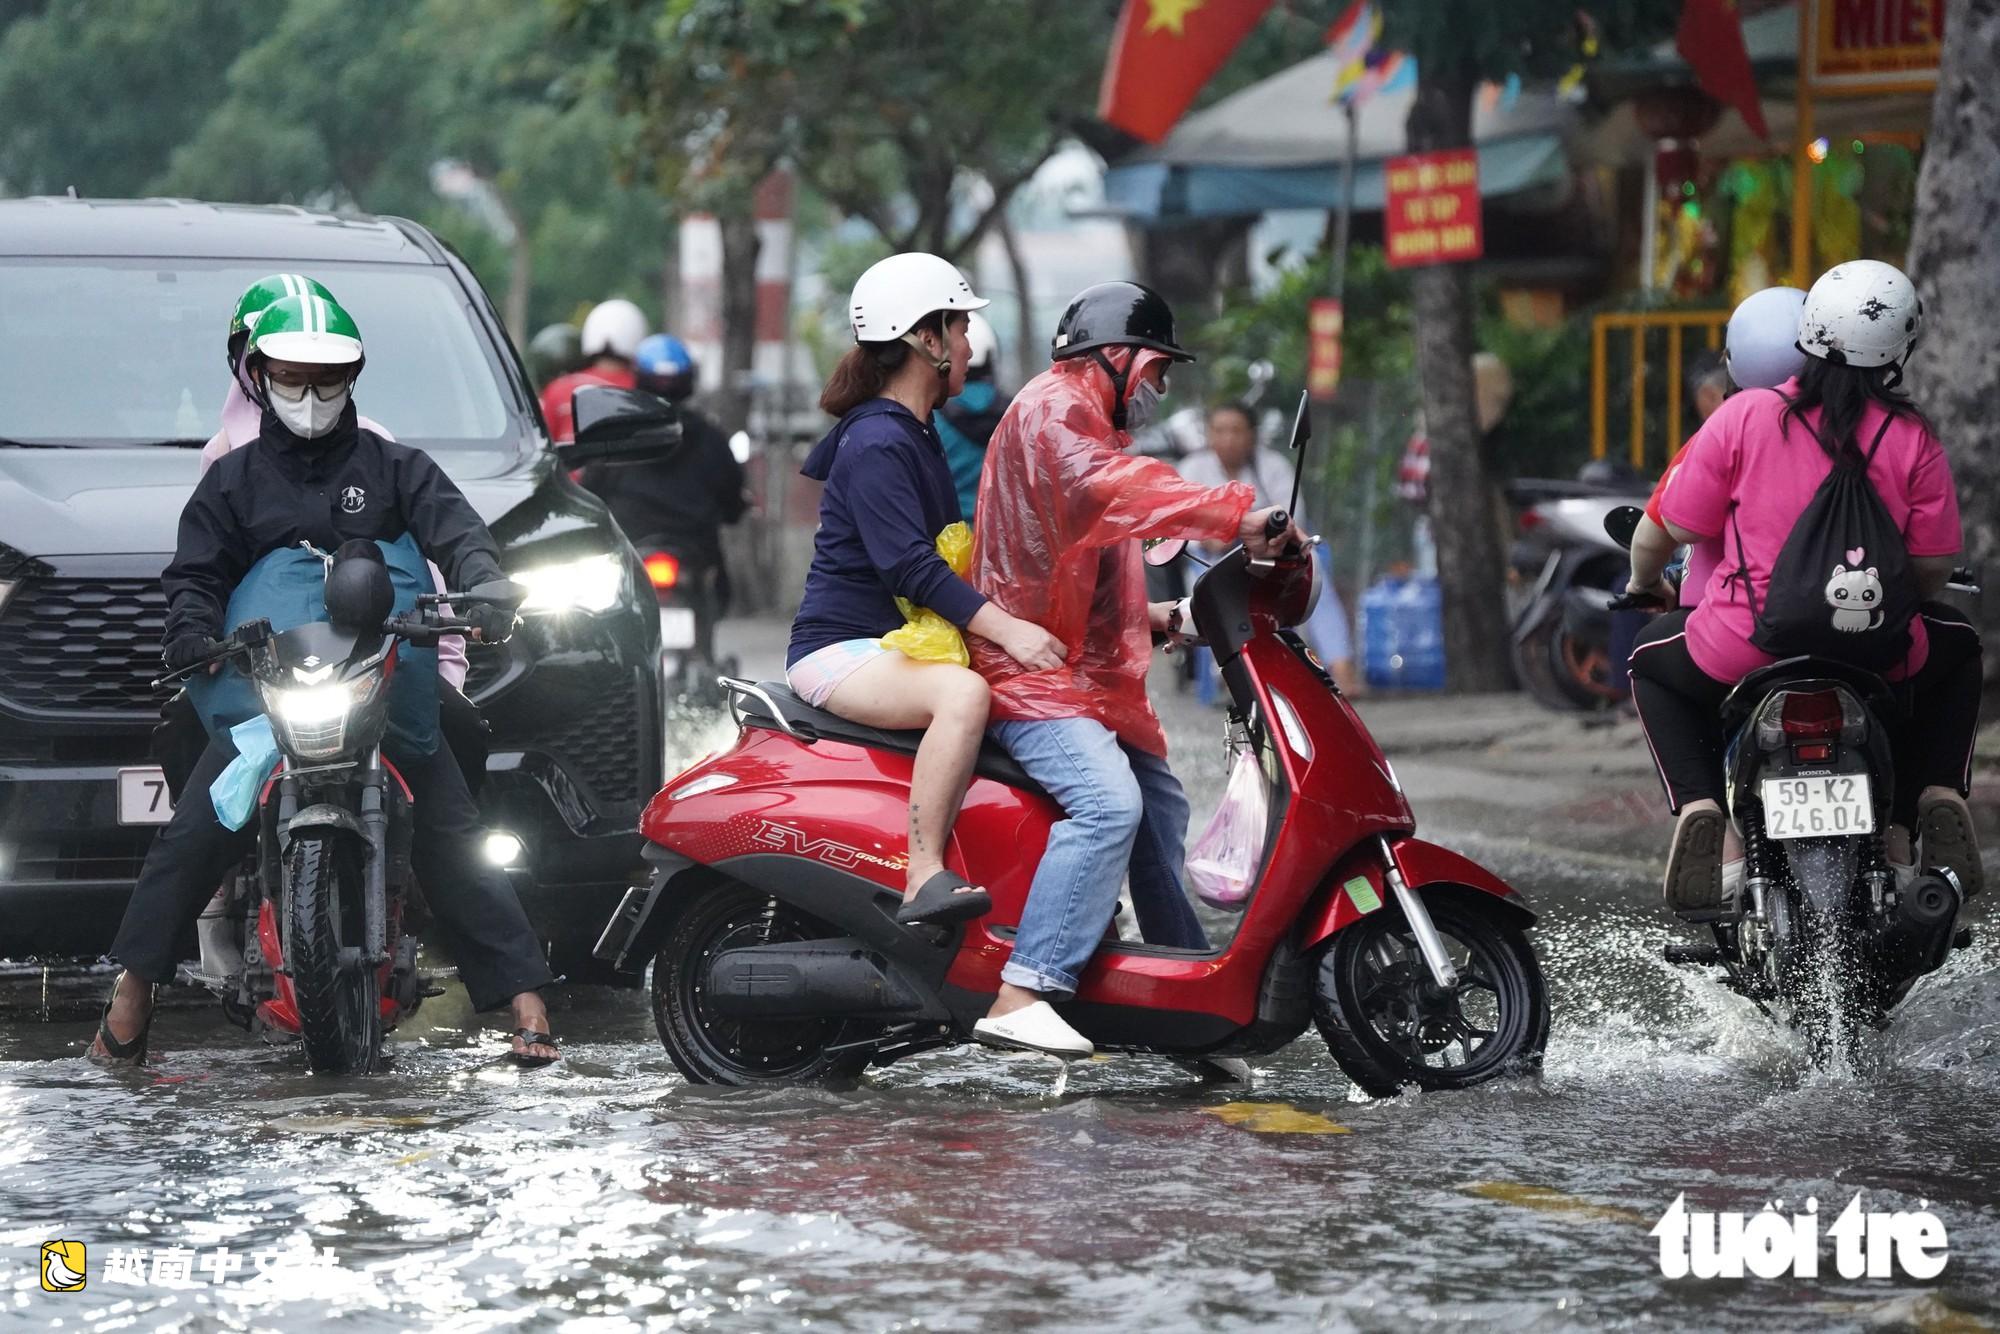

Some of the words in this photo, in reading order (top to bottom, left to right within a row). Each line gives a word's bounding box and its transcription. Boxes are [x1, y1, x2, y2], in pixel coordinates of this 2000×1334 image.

[1798, 769, 1832, 777] HONDA
[1779, 778, 1855, 806] 59-K2
[1771, 804, 1867, 835] 246.04
[855, 851, 904, 871] GRAND
